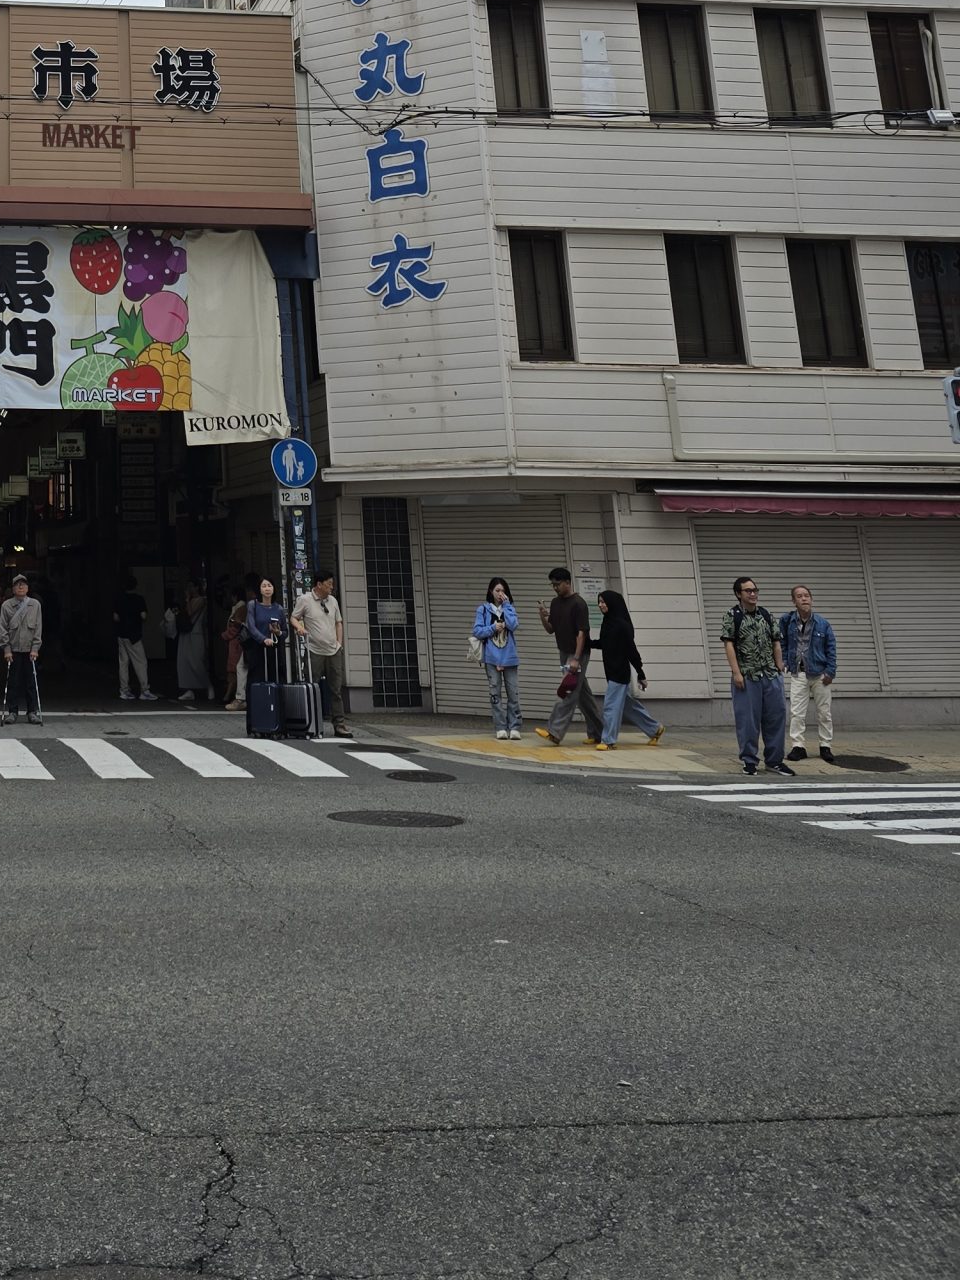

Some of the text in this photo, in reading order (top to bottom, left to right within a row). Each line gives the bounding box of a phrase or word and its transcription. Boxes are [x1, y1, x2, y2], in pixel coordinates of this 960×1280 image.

[41, 123, 141, 150] MARKET
[71, 387, 162, 403] MARKET
[189, 412, 283, 433] KUROMON
